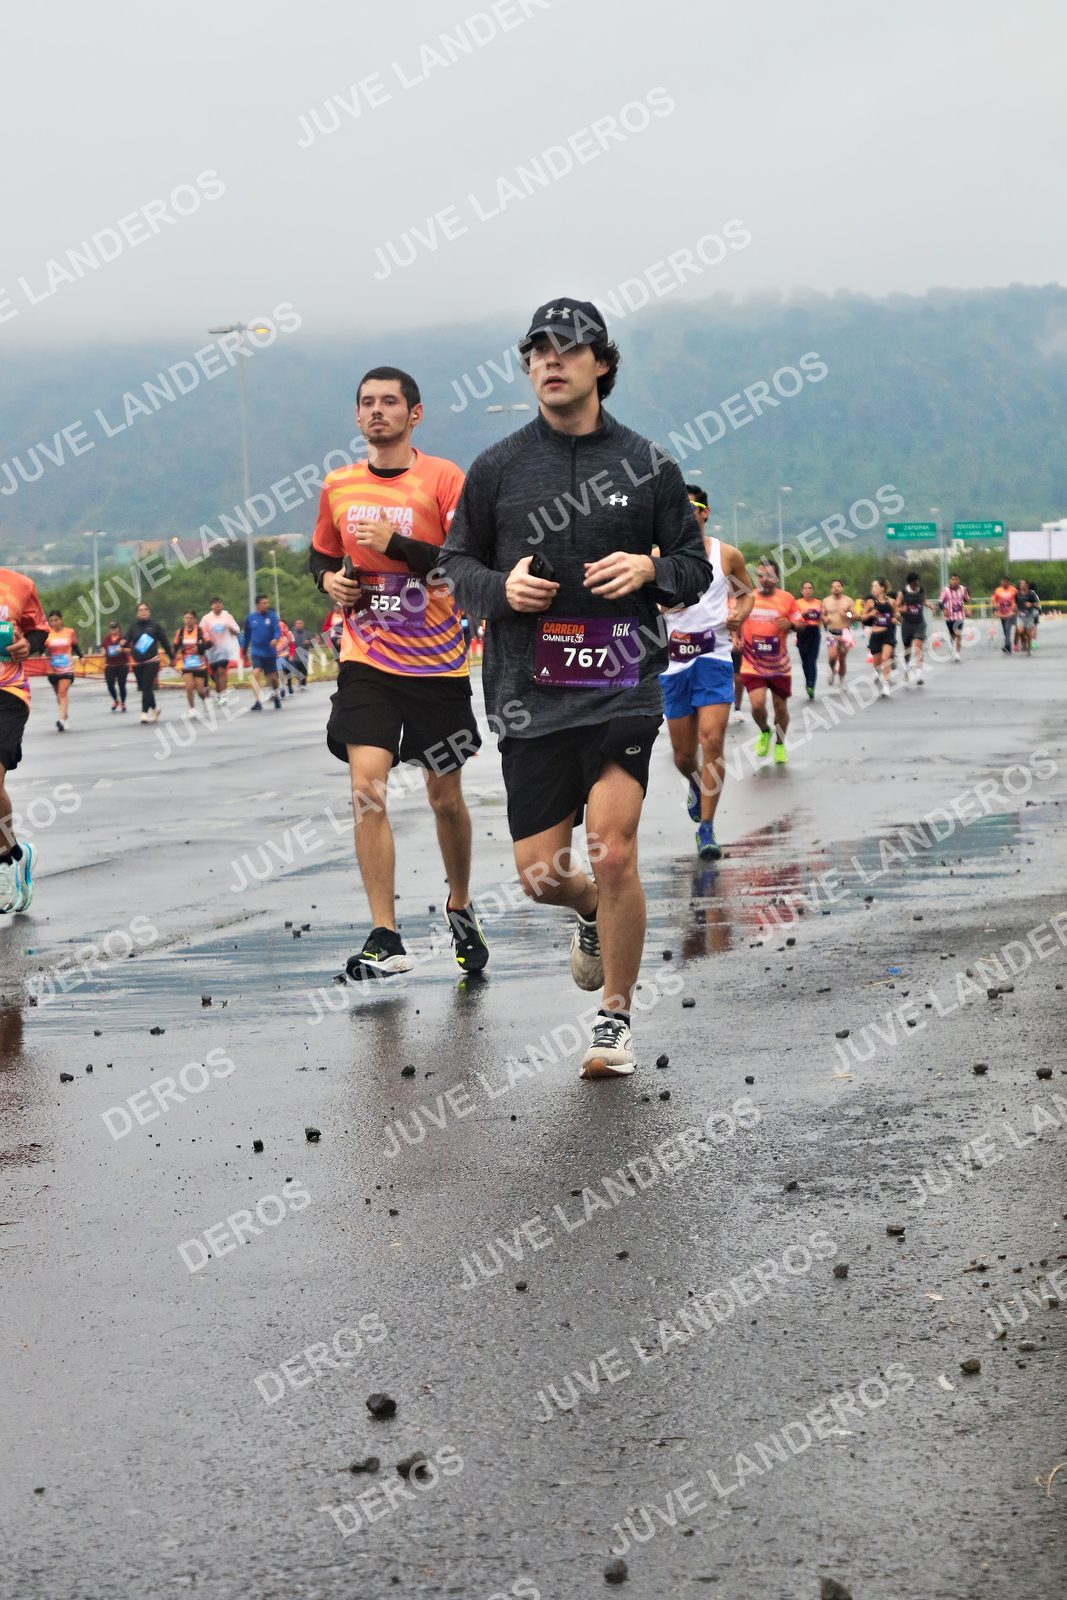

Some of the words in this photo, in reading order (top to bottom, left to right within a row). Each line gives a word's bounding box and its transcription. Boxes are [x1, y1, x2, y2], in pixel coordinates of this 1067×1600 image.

[370, 595, 401, 610] 552
[543, 622, 585, 634] CARRERA
[612, 623, 631, 637] 15K
[679, 644, 702, 654] 804
[757, 643, 773, 651] 389
[563, 647, 608, 668] 767
